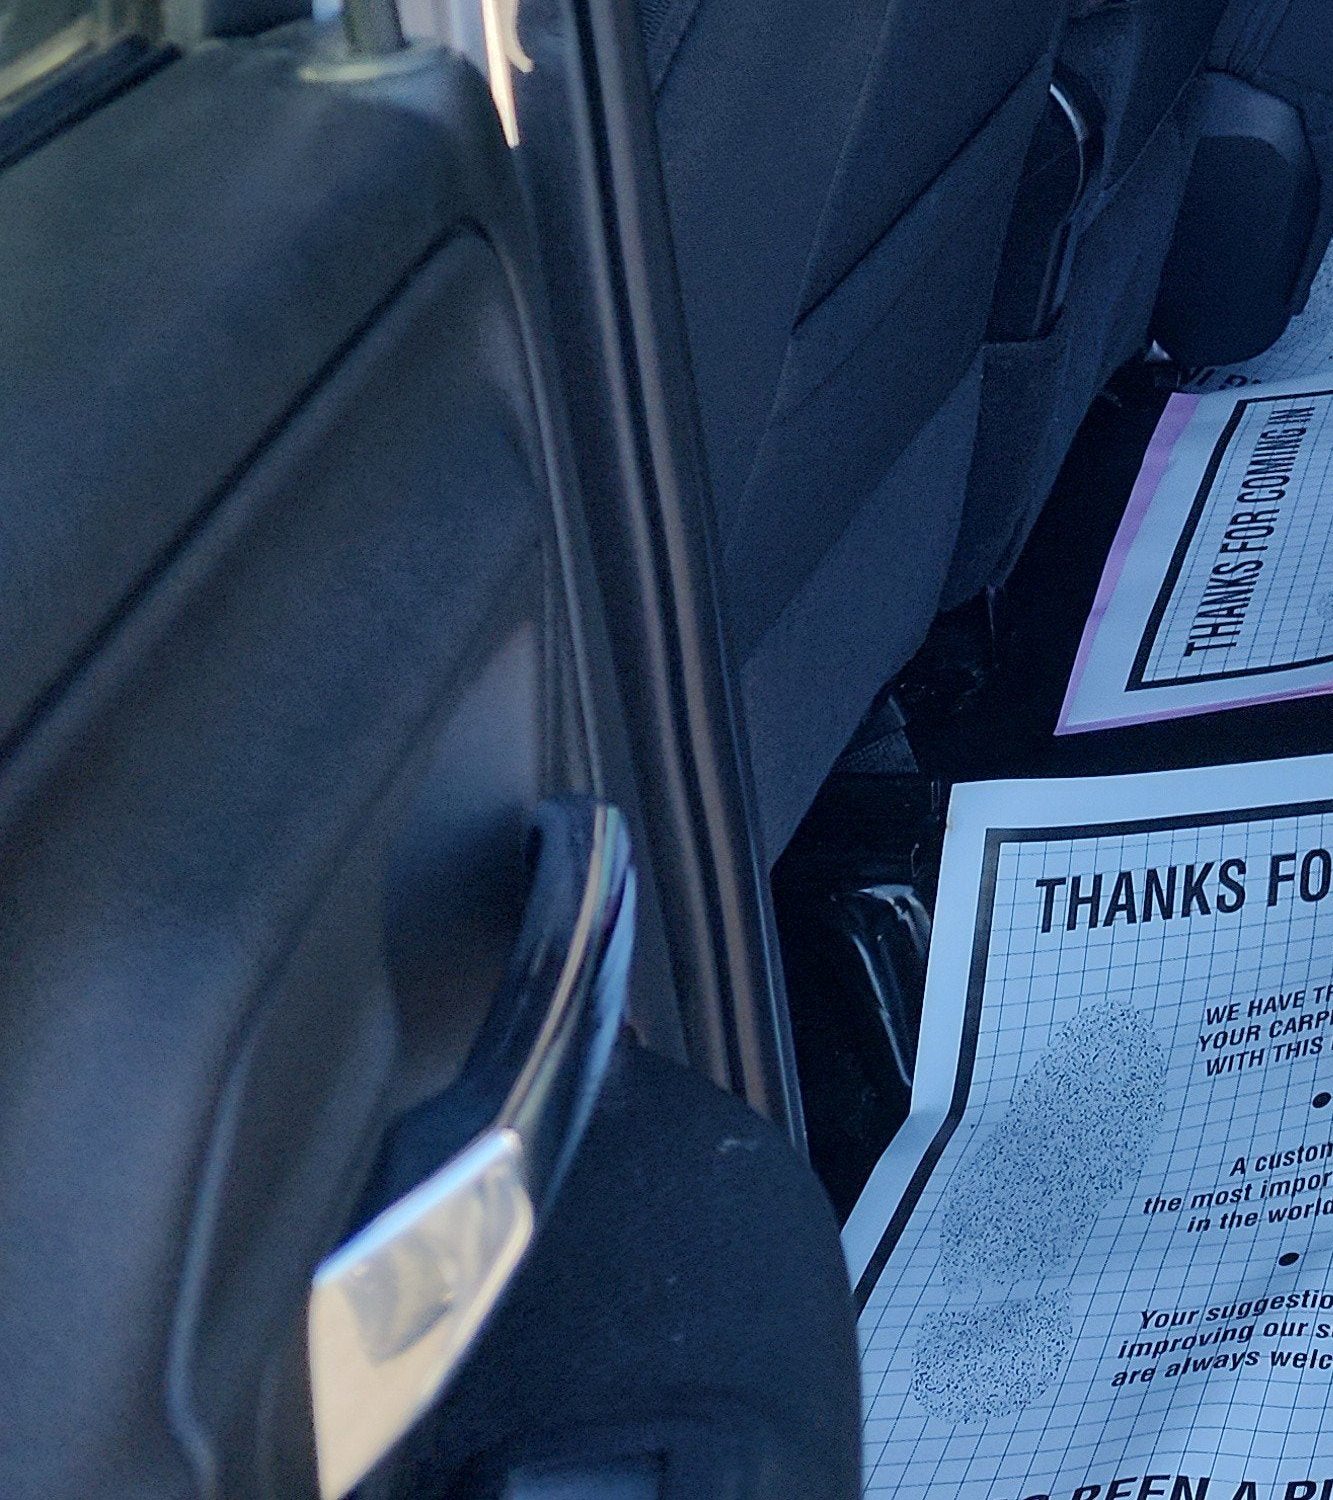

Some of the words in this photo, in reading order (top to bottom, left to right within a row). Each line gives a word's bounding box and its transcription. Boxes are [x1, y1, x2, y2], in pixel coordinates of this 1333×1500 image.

[1267, 406, 1316, 426] IN
[1236, 426, 1307, 502] COMING
[1220, 508, 1281, 555] FOR
[1183, 558, 1264, 658] THANKS
[1035, 857, 1247, 933] THANKS
[1206, 1002, 1241, 1025] WE
[1247, 989, 1306, 1018] HAVE
[1199, 1024, 1262, 1052] YOUR
[1206, 1047, 1264, 1077] WITH
[1273, 1035, 1324, 1063] THIS
[1230, 1155, 1248, 1177] A
[1143, 1195, 1183, 1215] the
[1190, 1182, 1253, 1209] most
[1187, 1215, 1211, 1234] in
[1219, 1208, 1259, 1230] the
[1140, 1308, 1200, 1330] Your
[1117, 1323, 1253, 1359] improving
[1262, 1319, 1309, 1338] our
[1111, 1366, 1157, 1388] are
[1163, 1348, 1261, 1380] always
